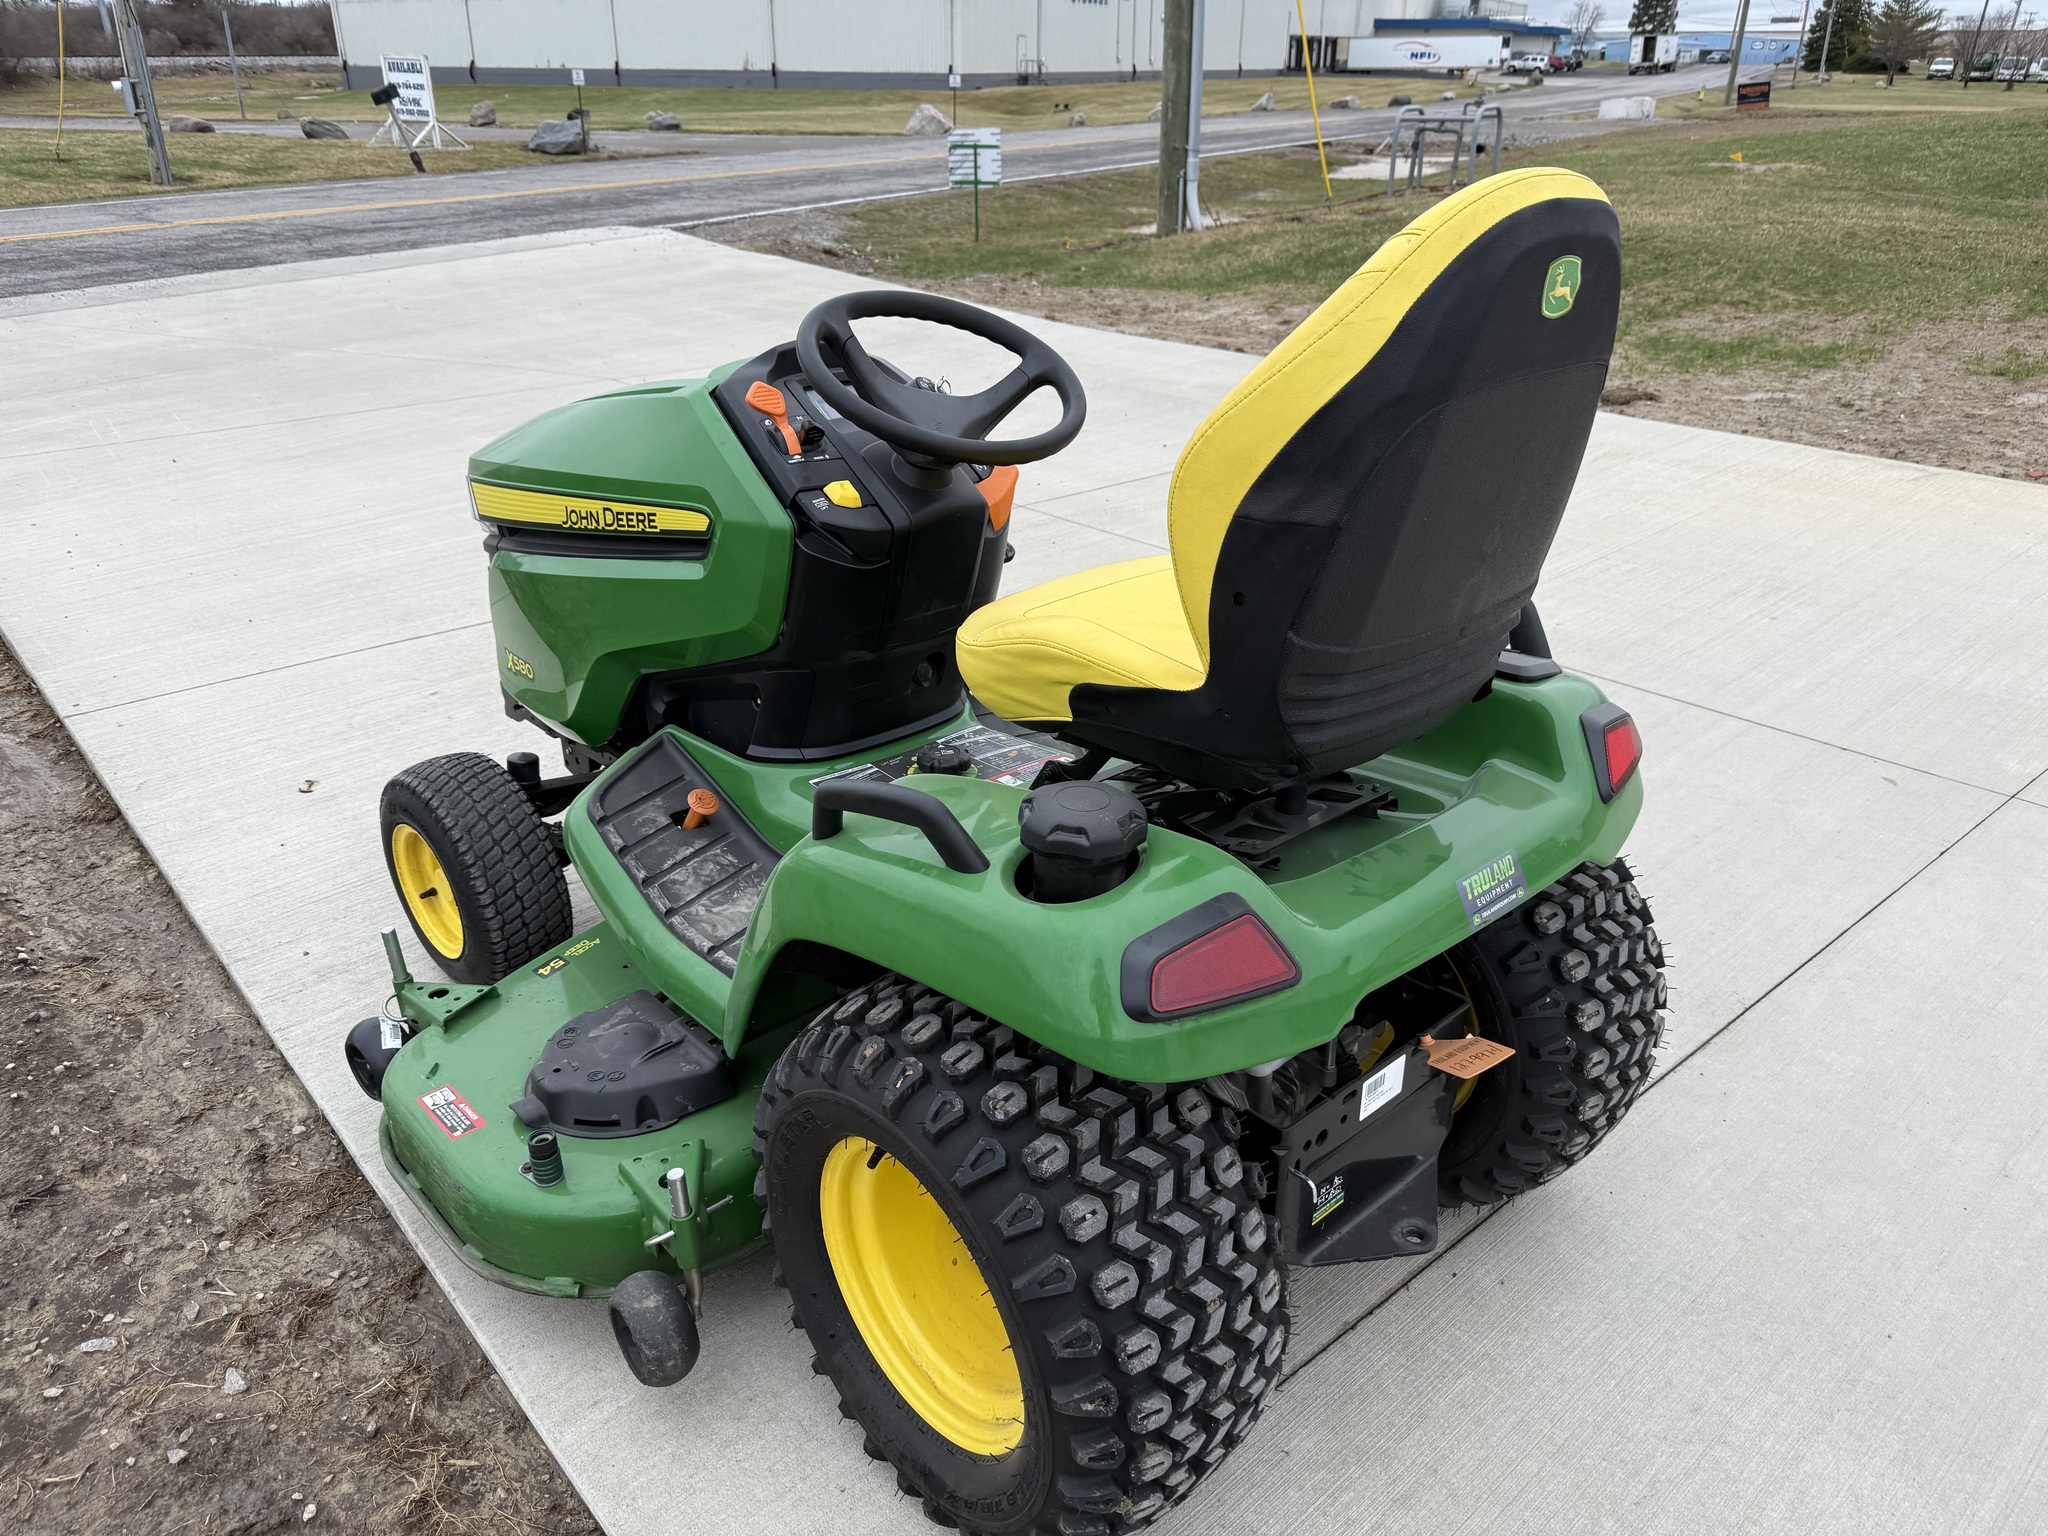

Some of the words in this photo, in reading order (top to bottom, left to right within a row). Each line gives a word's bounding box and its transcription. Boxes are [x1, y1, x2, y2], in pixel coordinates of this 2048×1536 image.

[1410, 51, 1431, 59] NFI
[561, 506, 601, 528] JOHN
[602, 507, 658, 530] DEERE
[505, 649, 534, 679] X580
[1462, 854, 1515, 900] TRULAND
[1476, 879, 1514, 907] EQUIPMENT
[537, 958, 566, 976] 54
